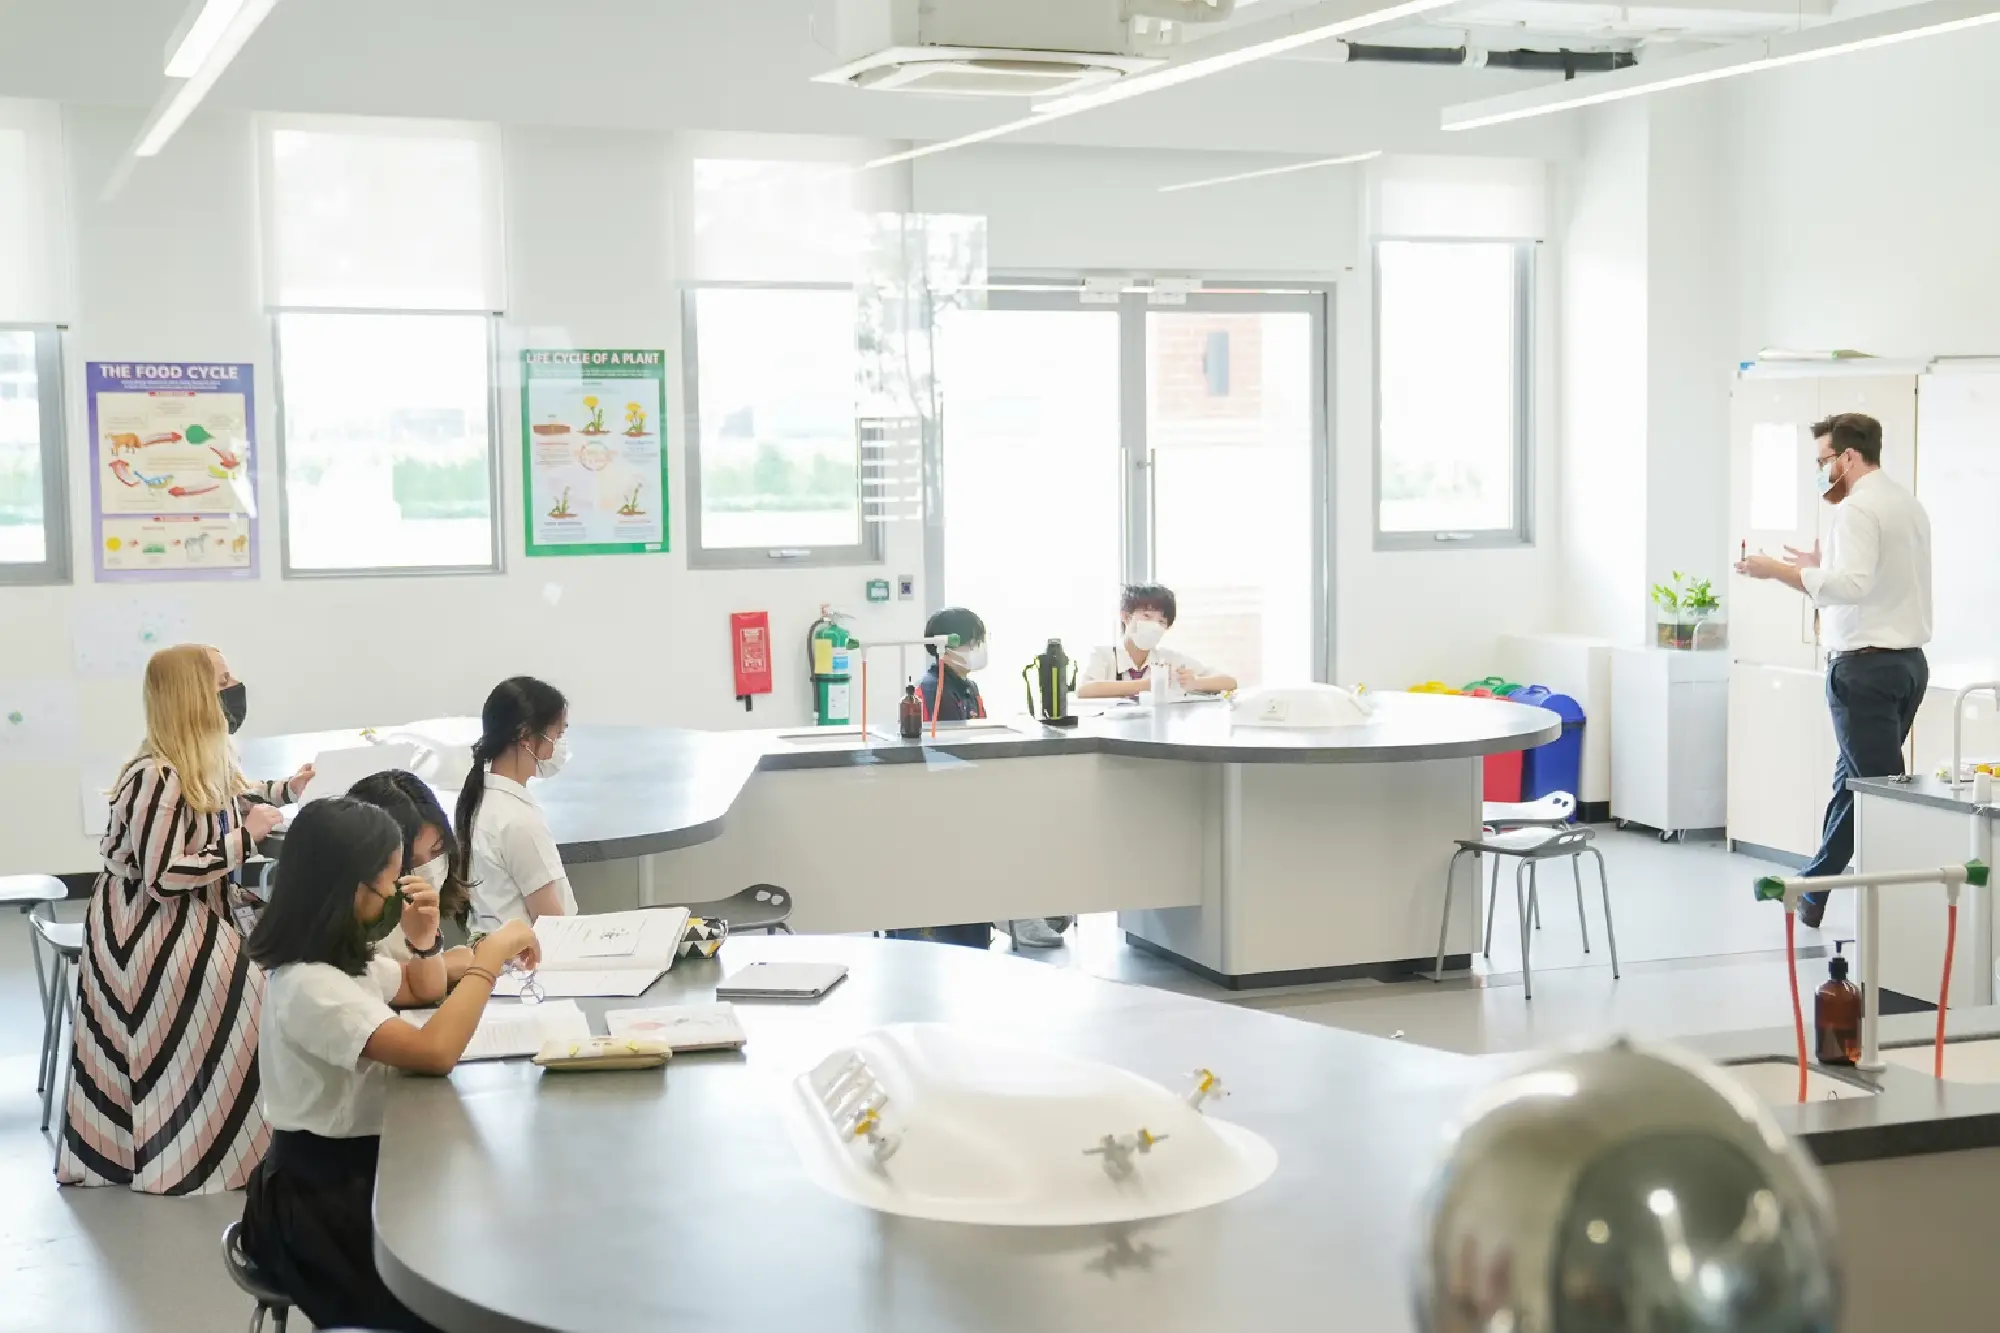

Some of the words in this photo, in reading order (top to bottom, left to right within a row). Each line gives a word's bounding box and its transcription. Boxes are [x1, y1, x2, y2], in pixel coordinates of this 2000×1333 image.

[526, 352, 549, 364] LIFE
[553, 352, 590, 364] CYCLE
[592, 352, 608, 364] OF
[611, 352, 621, 364] A
[623, 352, 660, 364] PLANT
[99, 364, 131, 379] THE
[136, 364, 182, 379] FOOD
[187, 365, 238, 379] CYCLE
